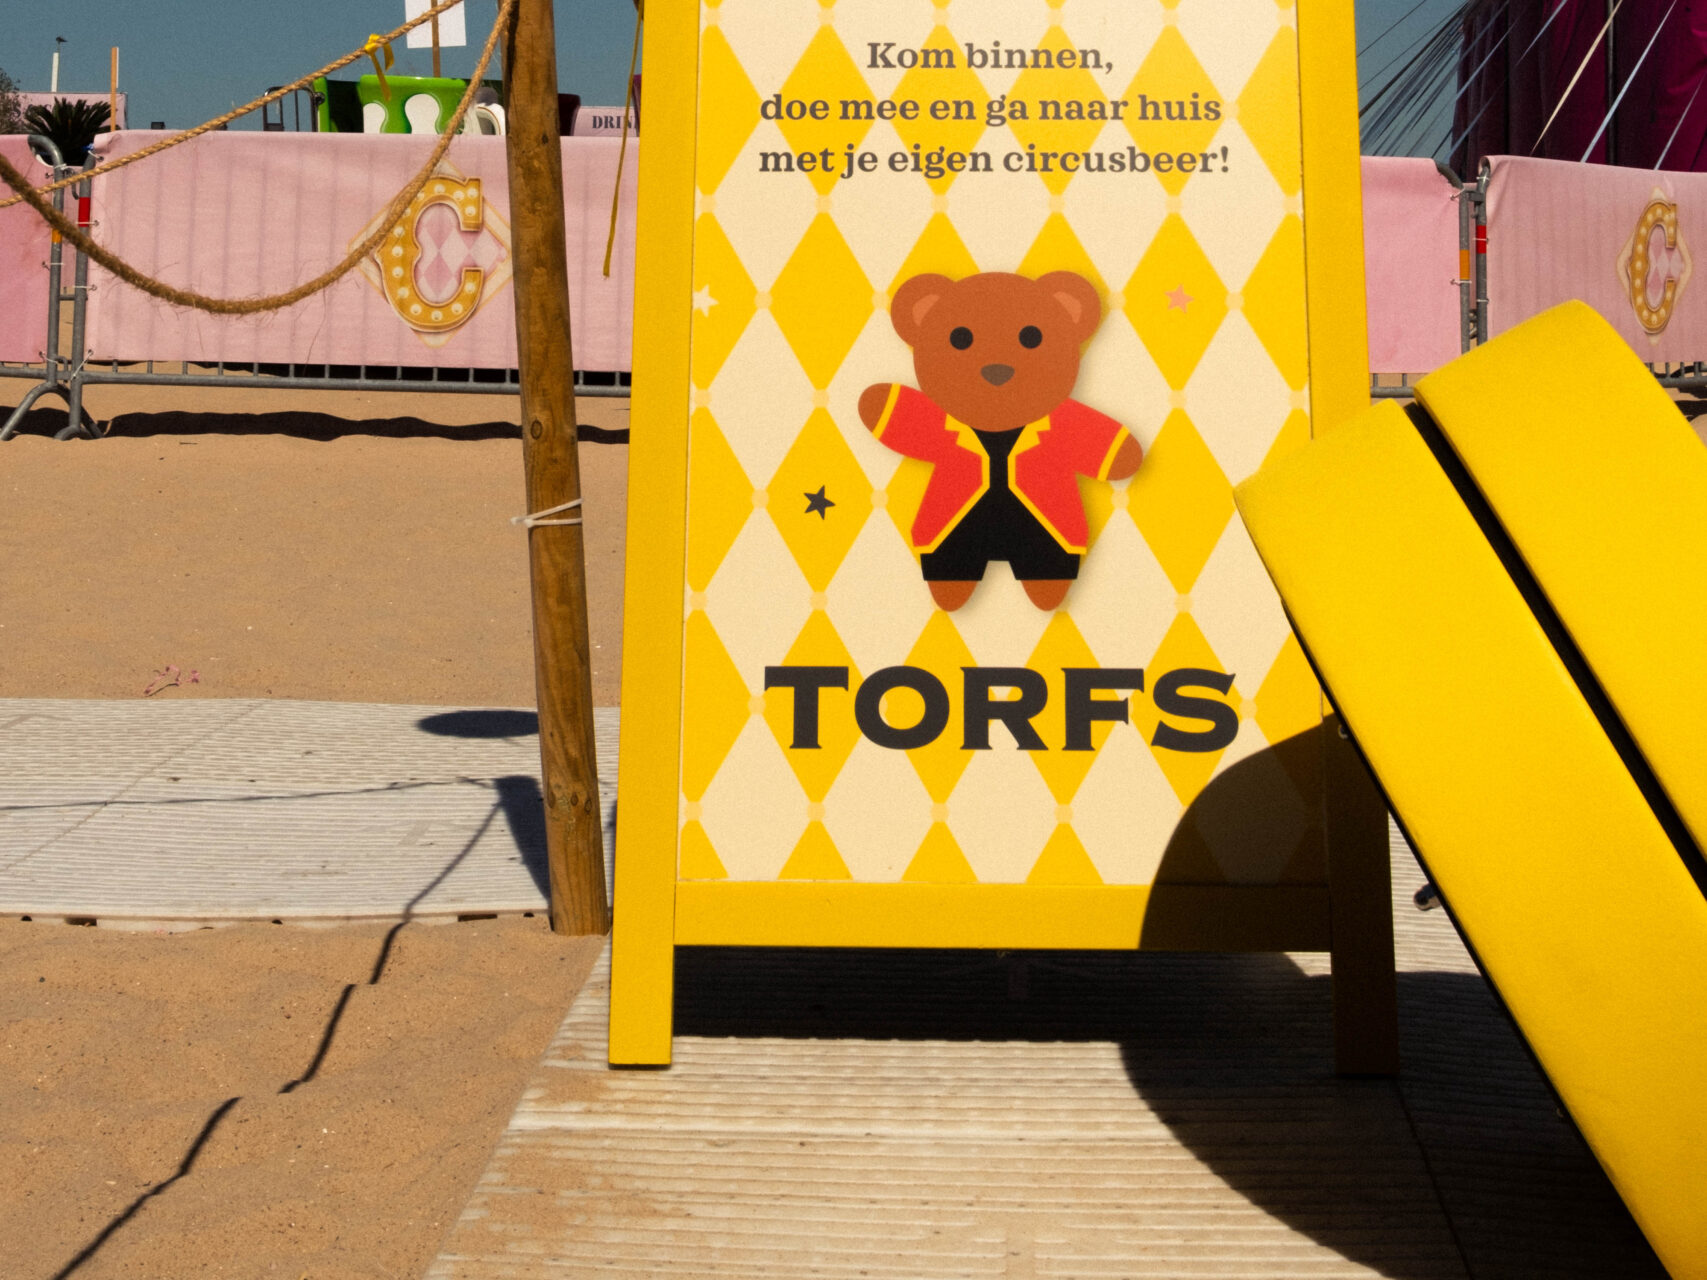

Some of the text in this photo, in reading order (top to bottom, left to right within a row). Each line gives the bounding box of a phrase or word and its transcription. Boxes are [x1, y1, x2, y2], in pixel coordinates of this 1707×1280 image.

[867, 41, 1114, 74] Kom binnen,
[760, 92, 1222, 127] doe mee en ga naar huis
[759, 144, 1231, 180] met je eigen circusbeer!
[764, 665, 1240, 753] TORFS
